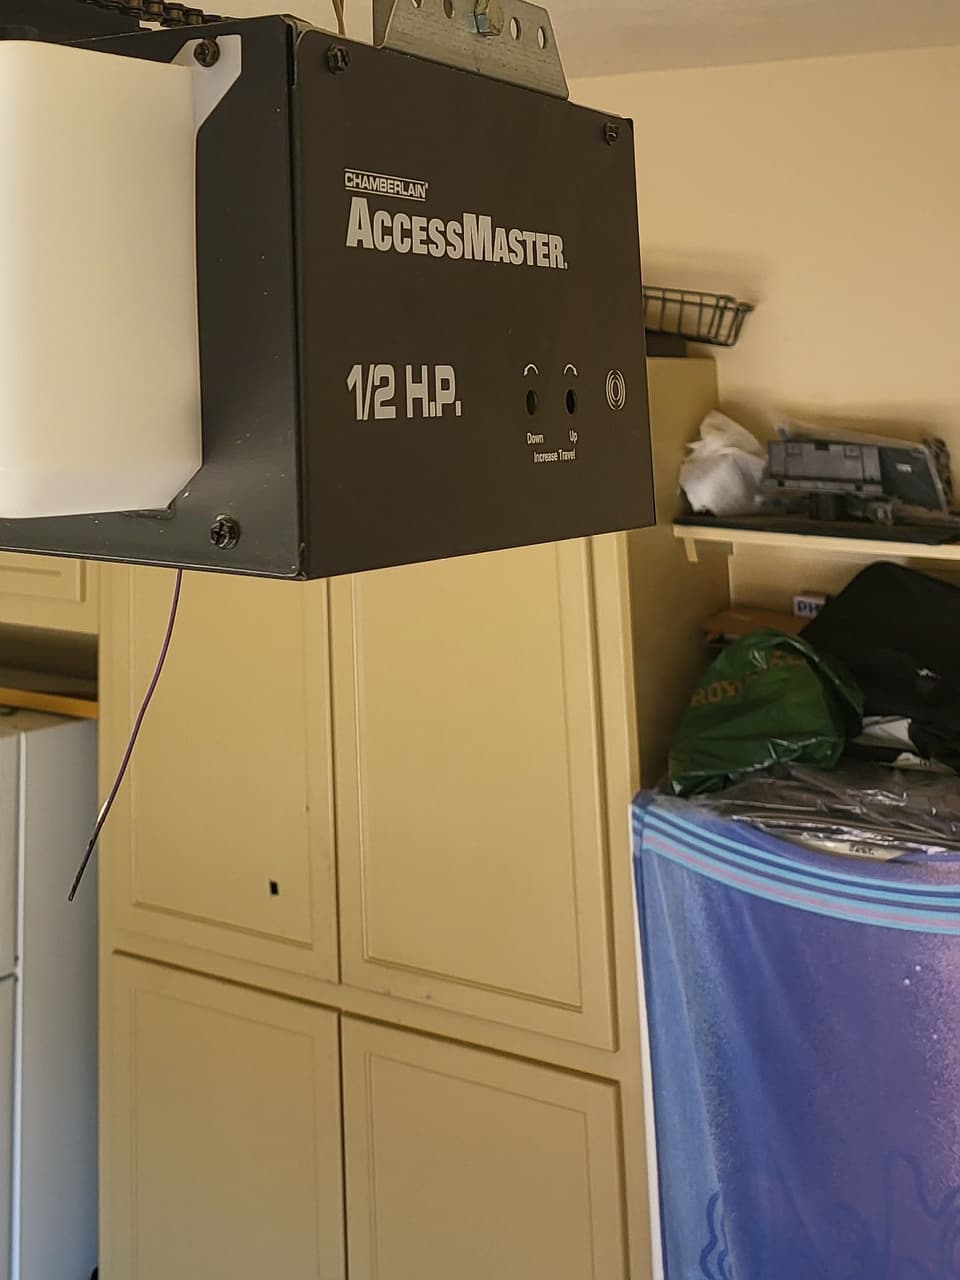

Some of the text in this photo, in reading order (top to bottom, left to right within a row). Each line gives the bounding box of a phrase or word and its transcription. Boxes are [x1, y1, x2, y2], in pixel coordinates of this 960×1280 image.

[344, 172, 427, 198] CHAMBERLAIN
[346, 363, 462, 421] 1/2 H.P.
[527, 429, 578, 445] Down Up
[533, 448, 576, 463] Increase Travel
